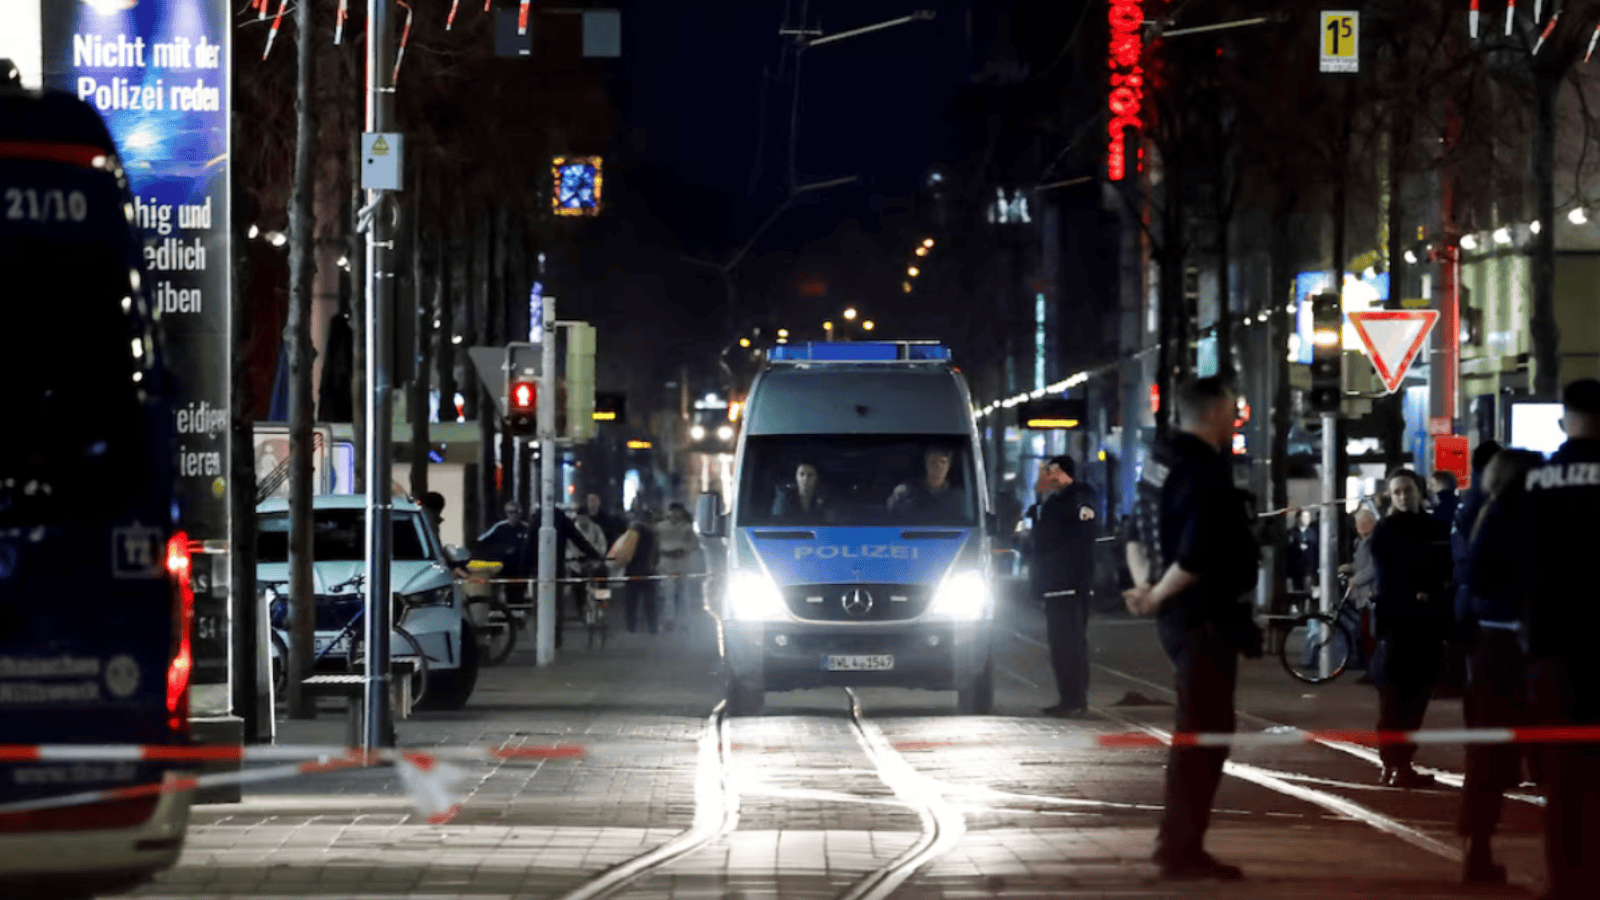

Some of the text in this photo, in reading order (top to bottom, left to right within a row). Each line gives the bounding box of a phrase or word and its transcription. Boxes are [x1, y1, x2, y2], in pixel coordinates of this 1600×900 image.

[73, 34, 220, 69] Nicht mit der
[78, 77, 219, 111] Polizei reden
[5, 188, 87, 221] 21/10
[178, 196, 211, 229] und
[794, 545, 918, 560] POLIZEI
